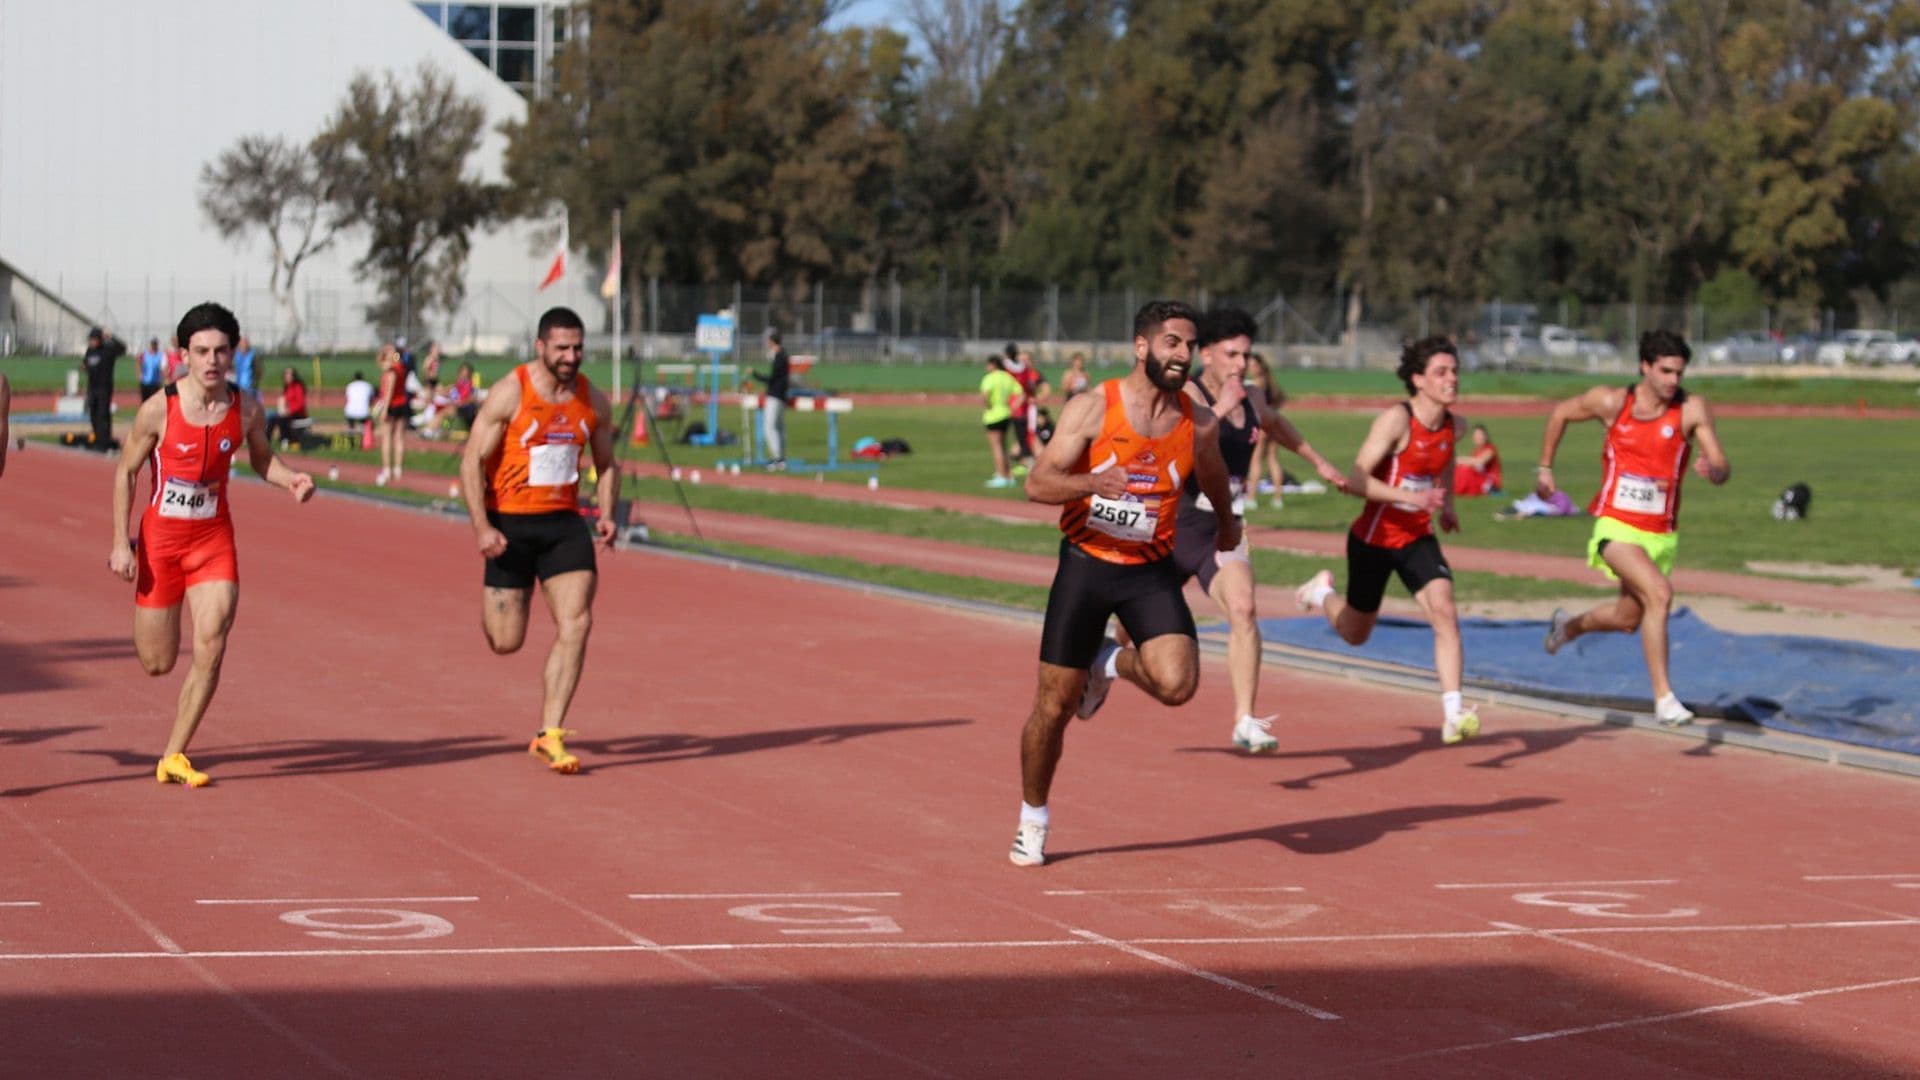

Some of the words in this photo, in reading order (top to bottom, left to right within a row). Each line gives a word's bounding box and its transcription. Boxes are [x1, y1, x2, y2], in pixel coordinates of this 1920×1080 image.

[1093, 503, 1141, 527] 2597
[1513, 891, 1698, 918] 3
[727, 904, 903, 934] 5
